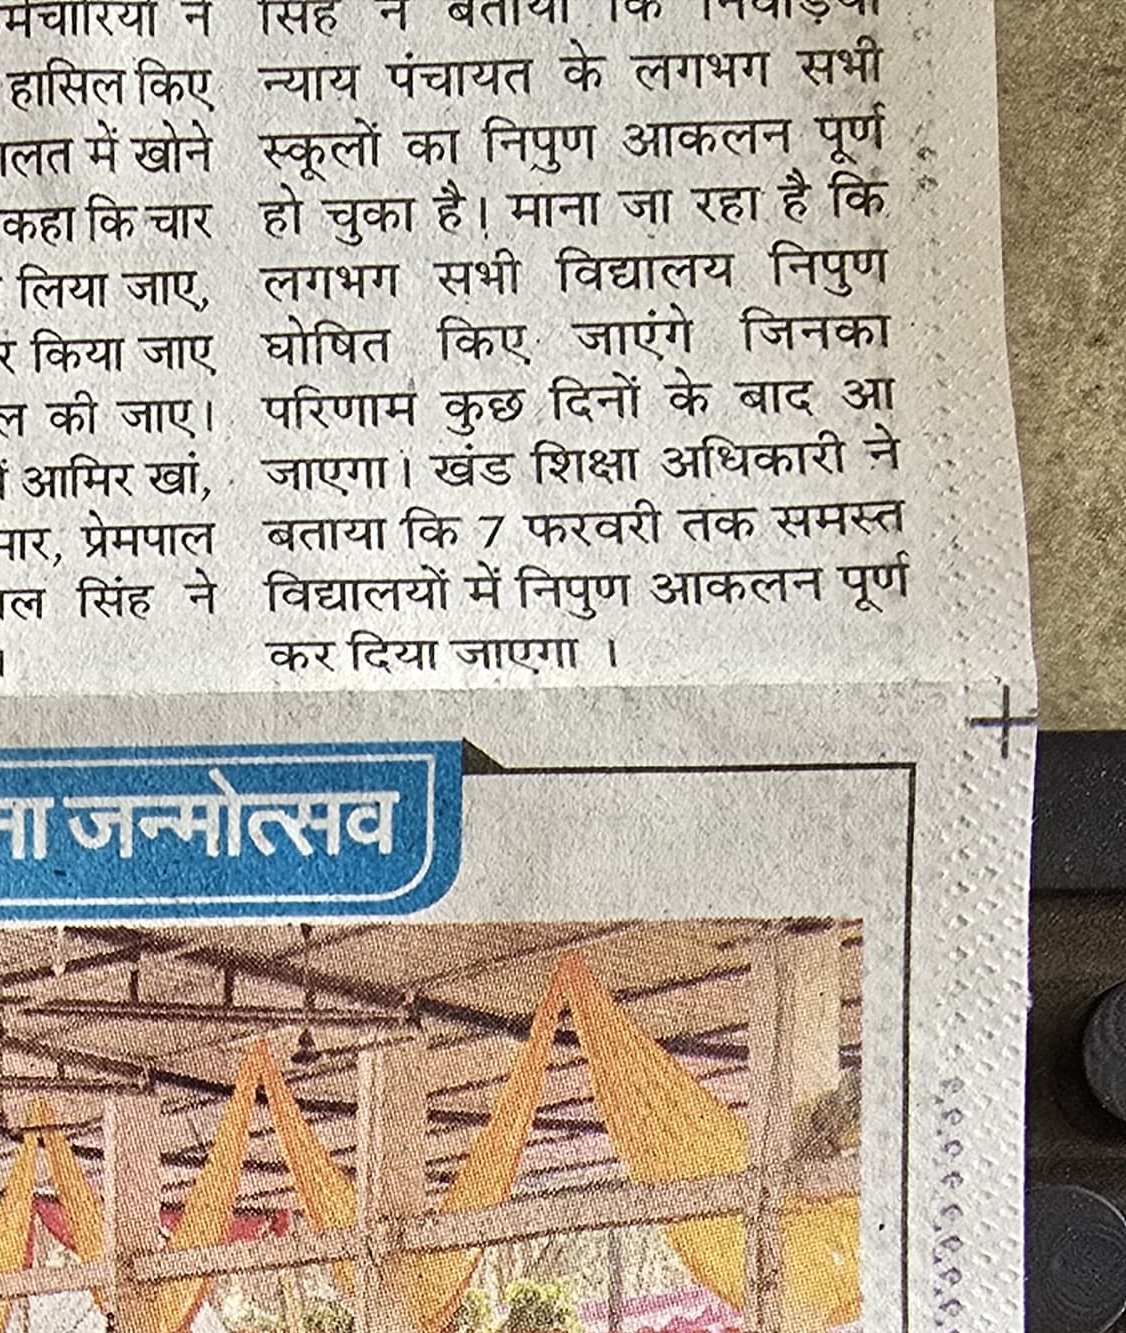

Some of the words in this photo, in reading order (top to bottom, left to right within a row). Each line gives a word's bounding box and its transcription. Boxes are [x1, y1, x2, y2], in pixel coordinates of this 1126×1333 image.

[257, 117, 382, 181] स्कूलों
[402, 129, 460, 165] का
[481, 115, 597, 174] निपुण
[623, 119, 792, 158] आकलन
[813, 101, 885, 165] पूर्ण
[85, 193, 138, 242] कि
[145, 204, 213, 240] चार
[80, 509, 216, 558] प्रेमपाल
[262, 518, 387, 551] बताया
[399, 506, 462, 549] कि
[478, 515, 505, 548] 7
[522, 499, 662, 547] फरवरी
[676, 507, 758, 542] तक
[770, 500, 906, 539] समस्त
[63, 768, 400, 858] जन्मोत्सव
